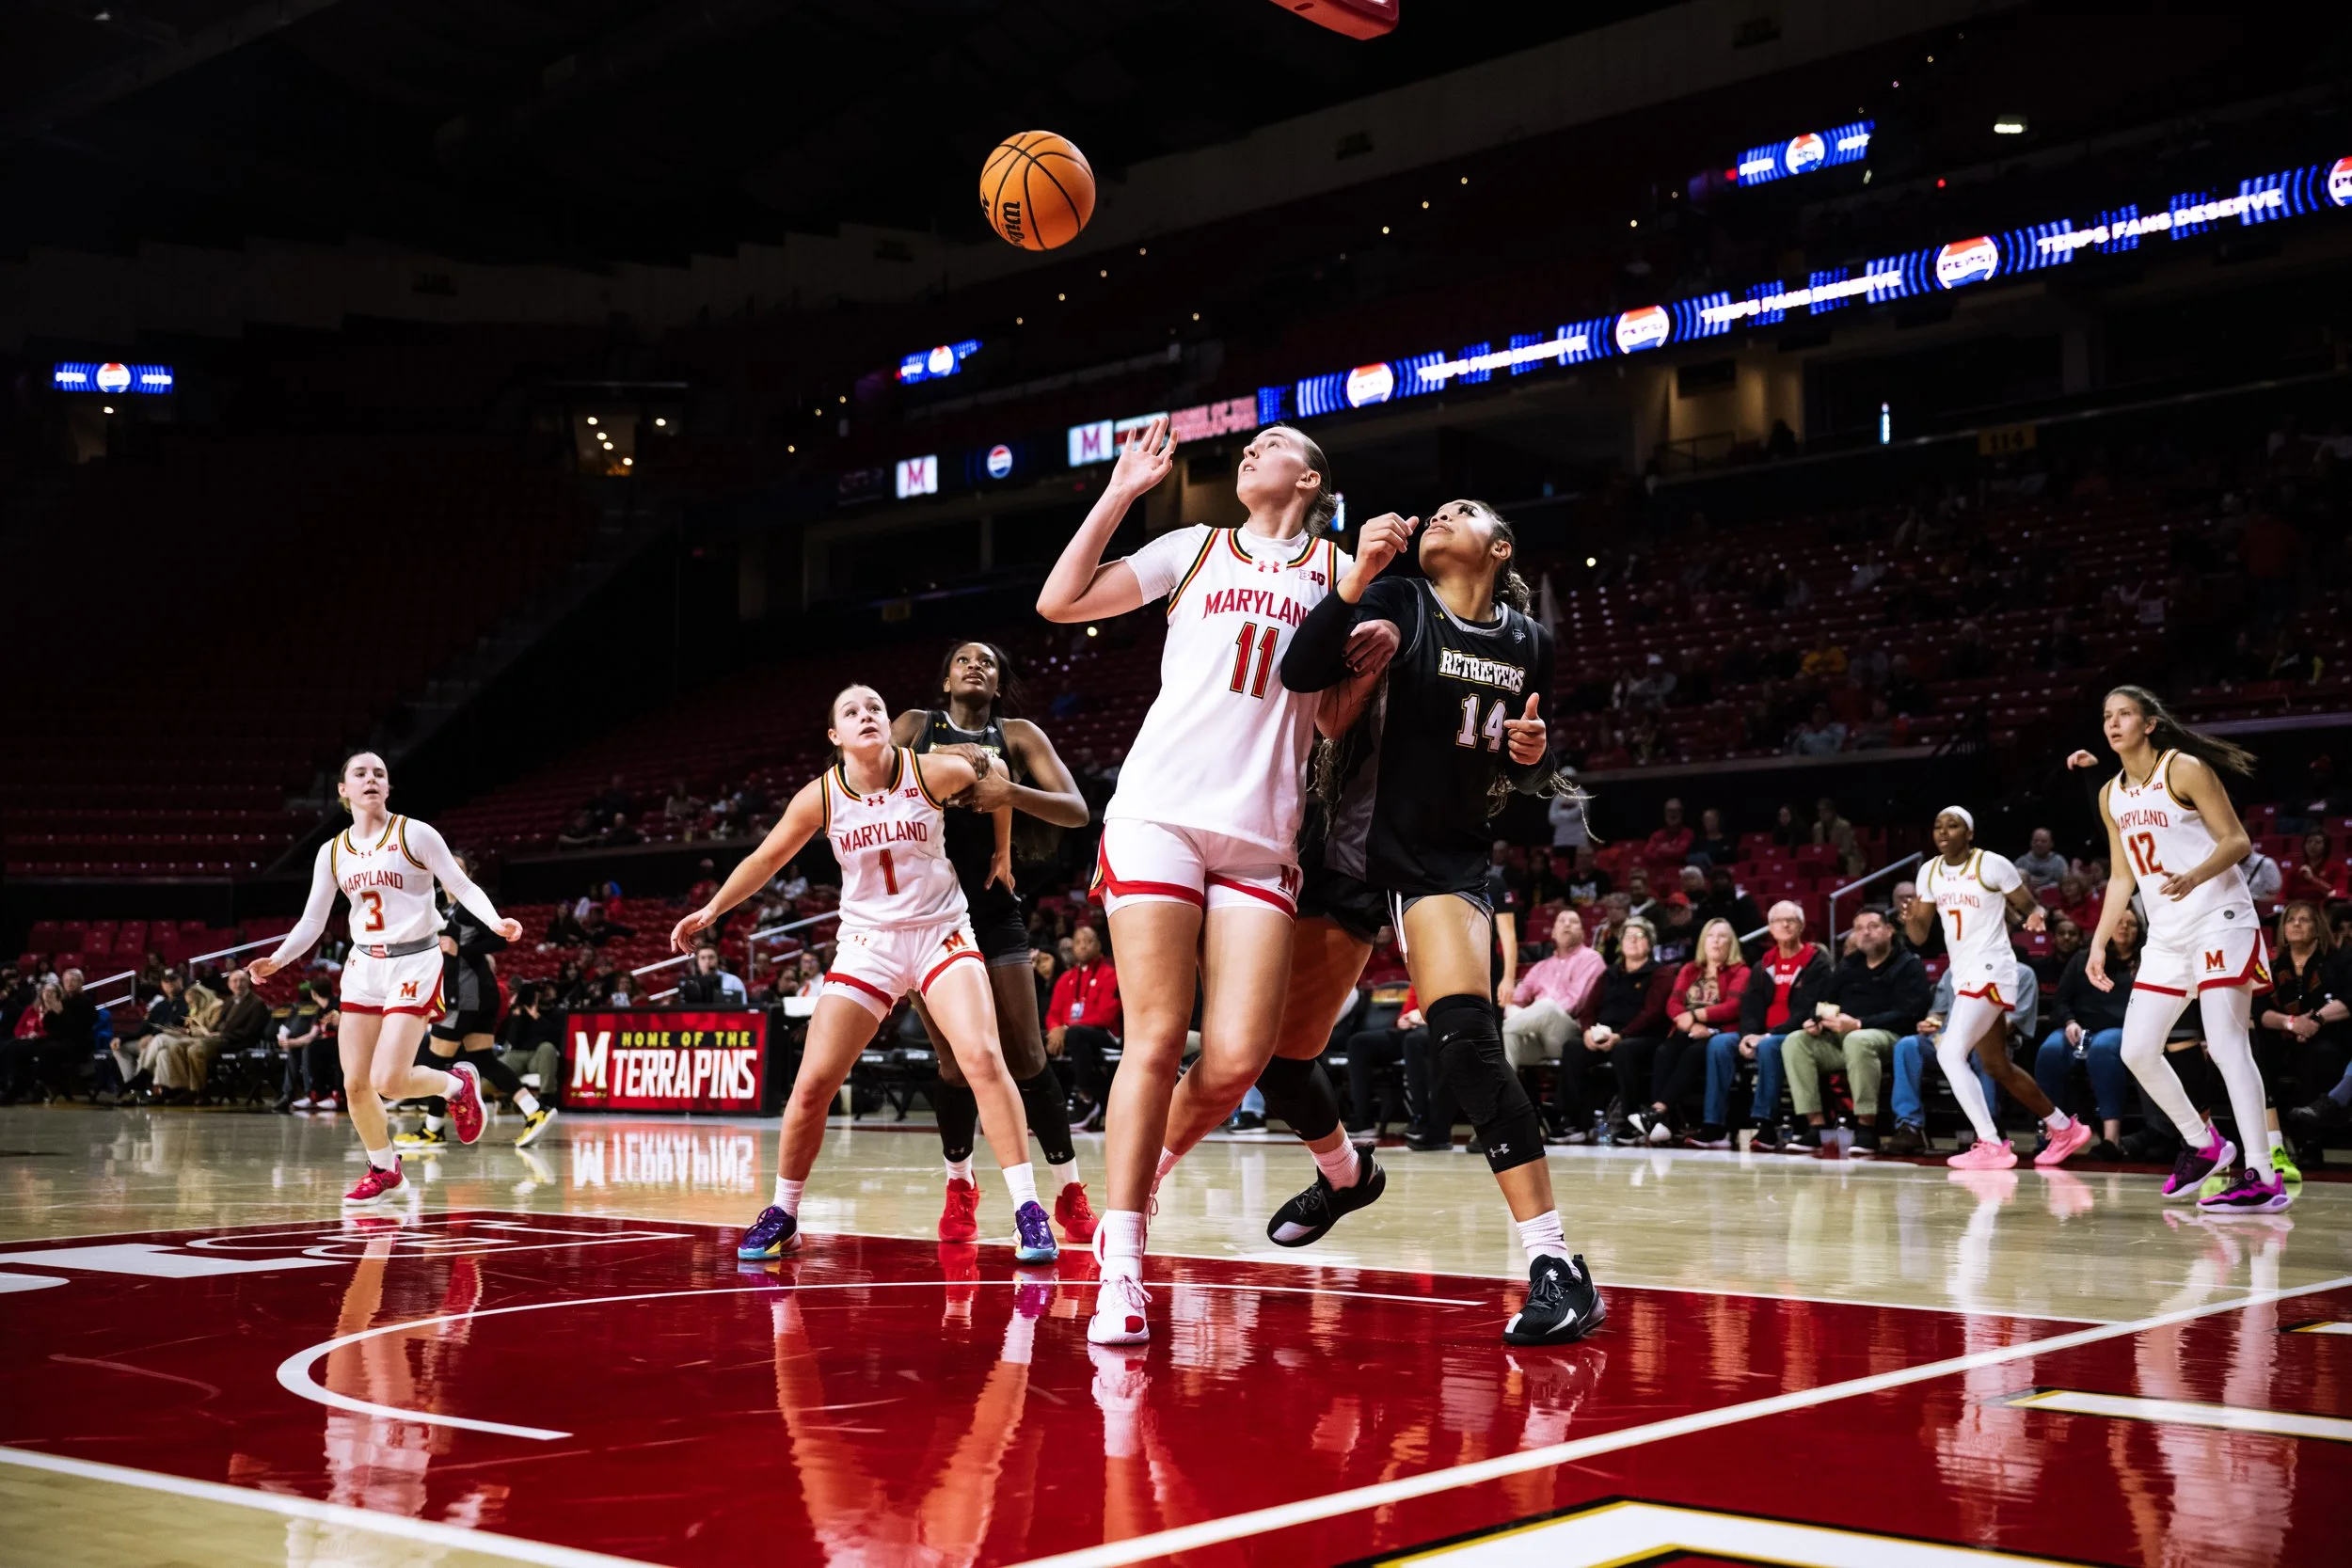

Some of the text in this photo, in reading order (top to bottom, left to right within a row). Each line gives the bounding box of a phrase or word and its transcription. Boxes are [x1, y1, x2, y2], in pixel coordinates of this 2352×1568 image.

[2038, 188, 2281, 254] TERPS FANS DESERVE
[1082, 426, 1101, 456] M
[908, 460, 926, 492] M
[1202, 588, 1311, 629] MARYLAN
[1230, 622, 1279, 699] 11
[1438, 648, 1526, 694] RETRIEVERS
[1456, 693, 1506, 752] 14
[839, 821, 929, 855] MARYLAND
[2117, 809, 2169, 832] ARYLAND
[880, 849, 899, 895] 1
[2128, 832, 2163, 877] 12
[1279, 864, 1299, 900] M
[360, 891, 386, 932] 3
[1948, 910, 1963, 942] 7
[942, 930, 968, 953] M
[2205, 950, 2226, 970] M
[399, 981, 420, 999] M
[622, 1032, 751, 1047] HOME OF THE
[571, 1031, 612, 1088] M
[612, 1049, 757, 1099] TERRAPINS
